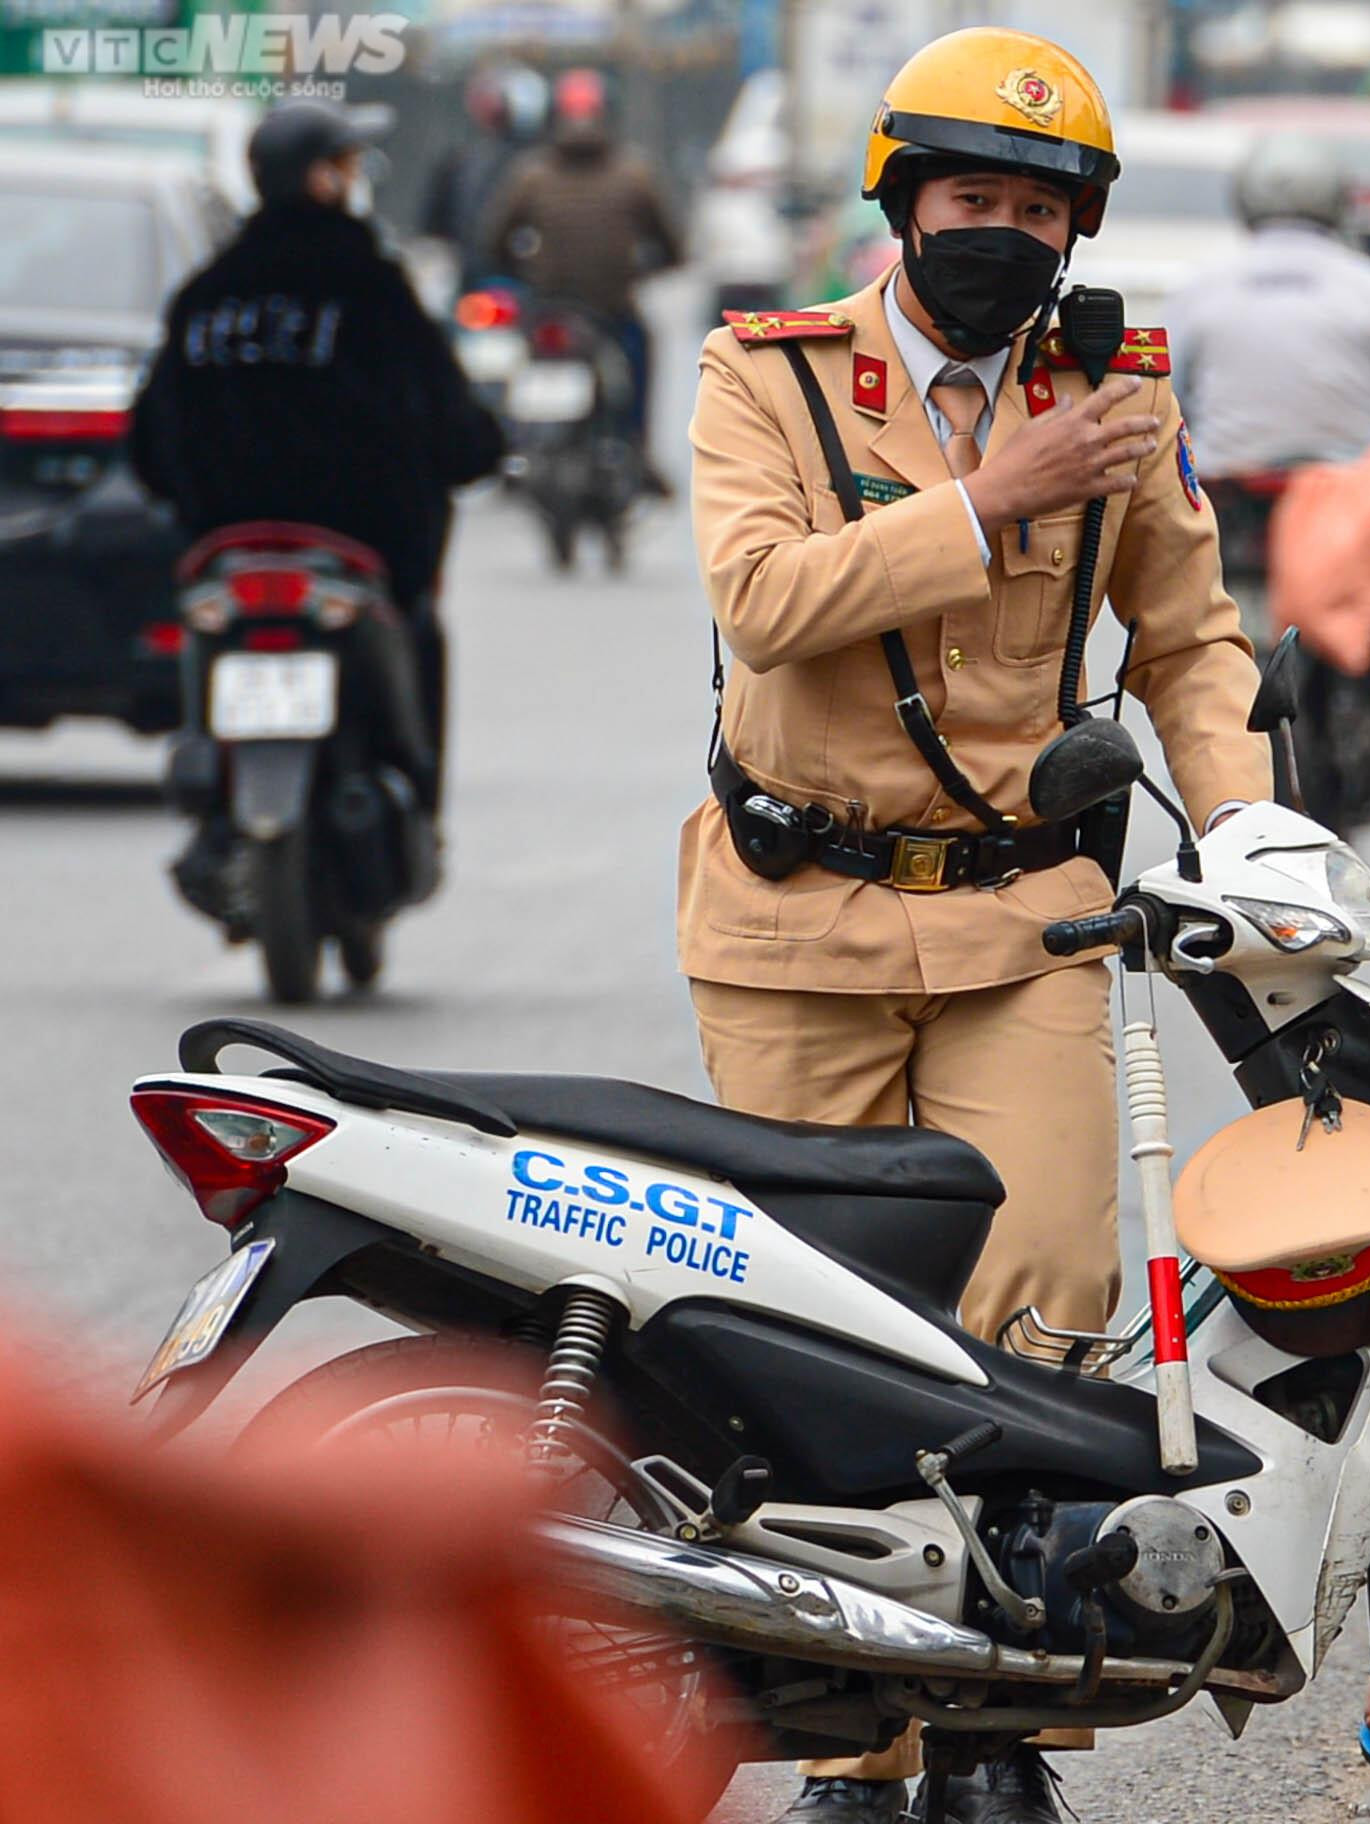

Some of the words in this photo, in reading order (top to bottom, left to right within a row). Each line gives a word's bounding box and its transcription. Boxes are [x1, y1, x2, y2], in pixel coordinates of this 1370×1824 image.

[507, 1189, 627, 1247] TRAFFIC
[646, 1226, 750, 1283] POLICE
[512, 1150, 754, 1241] C.S.G.T
